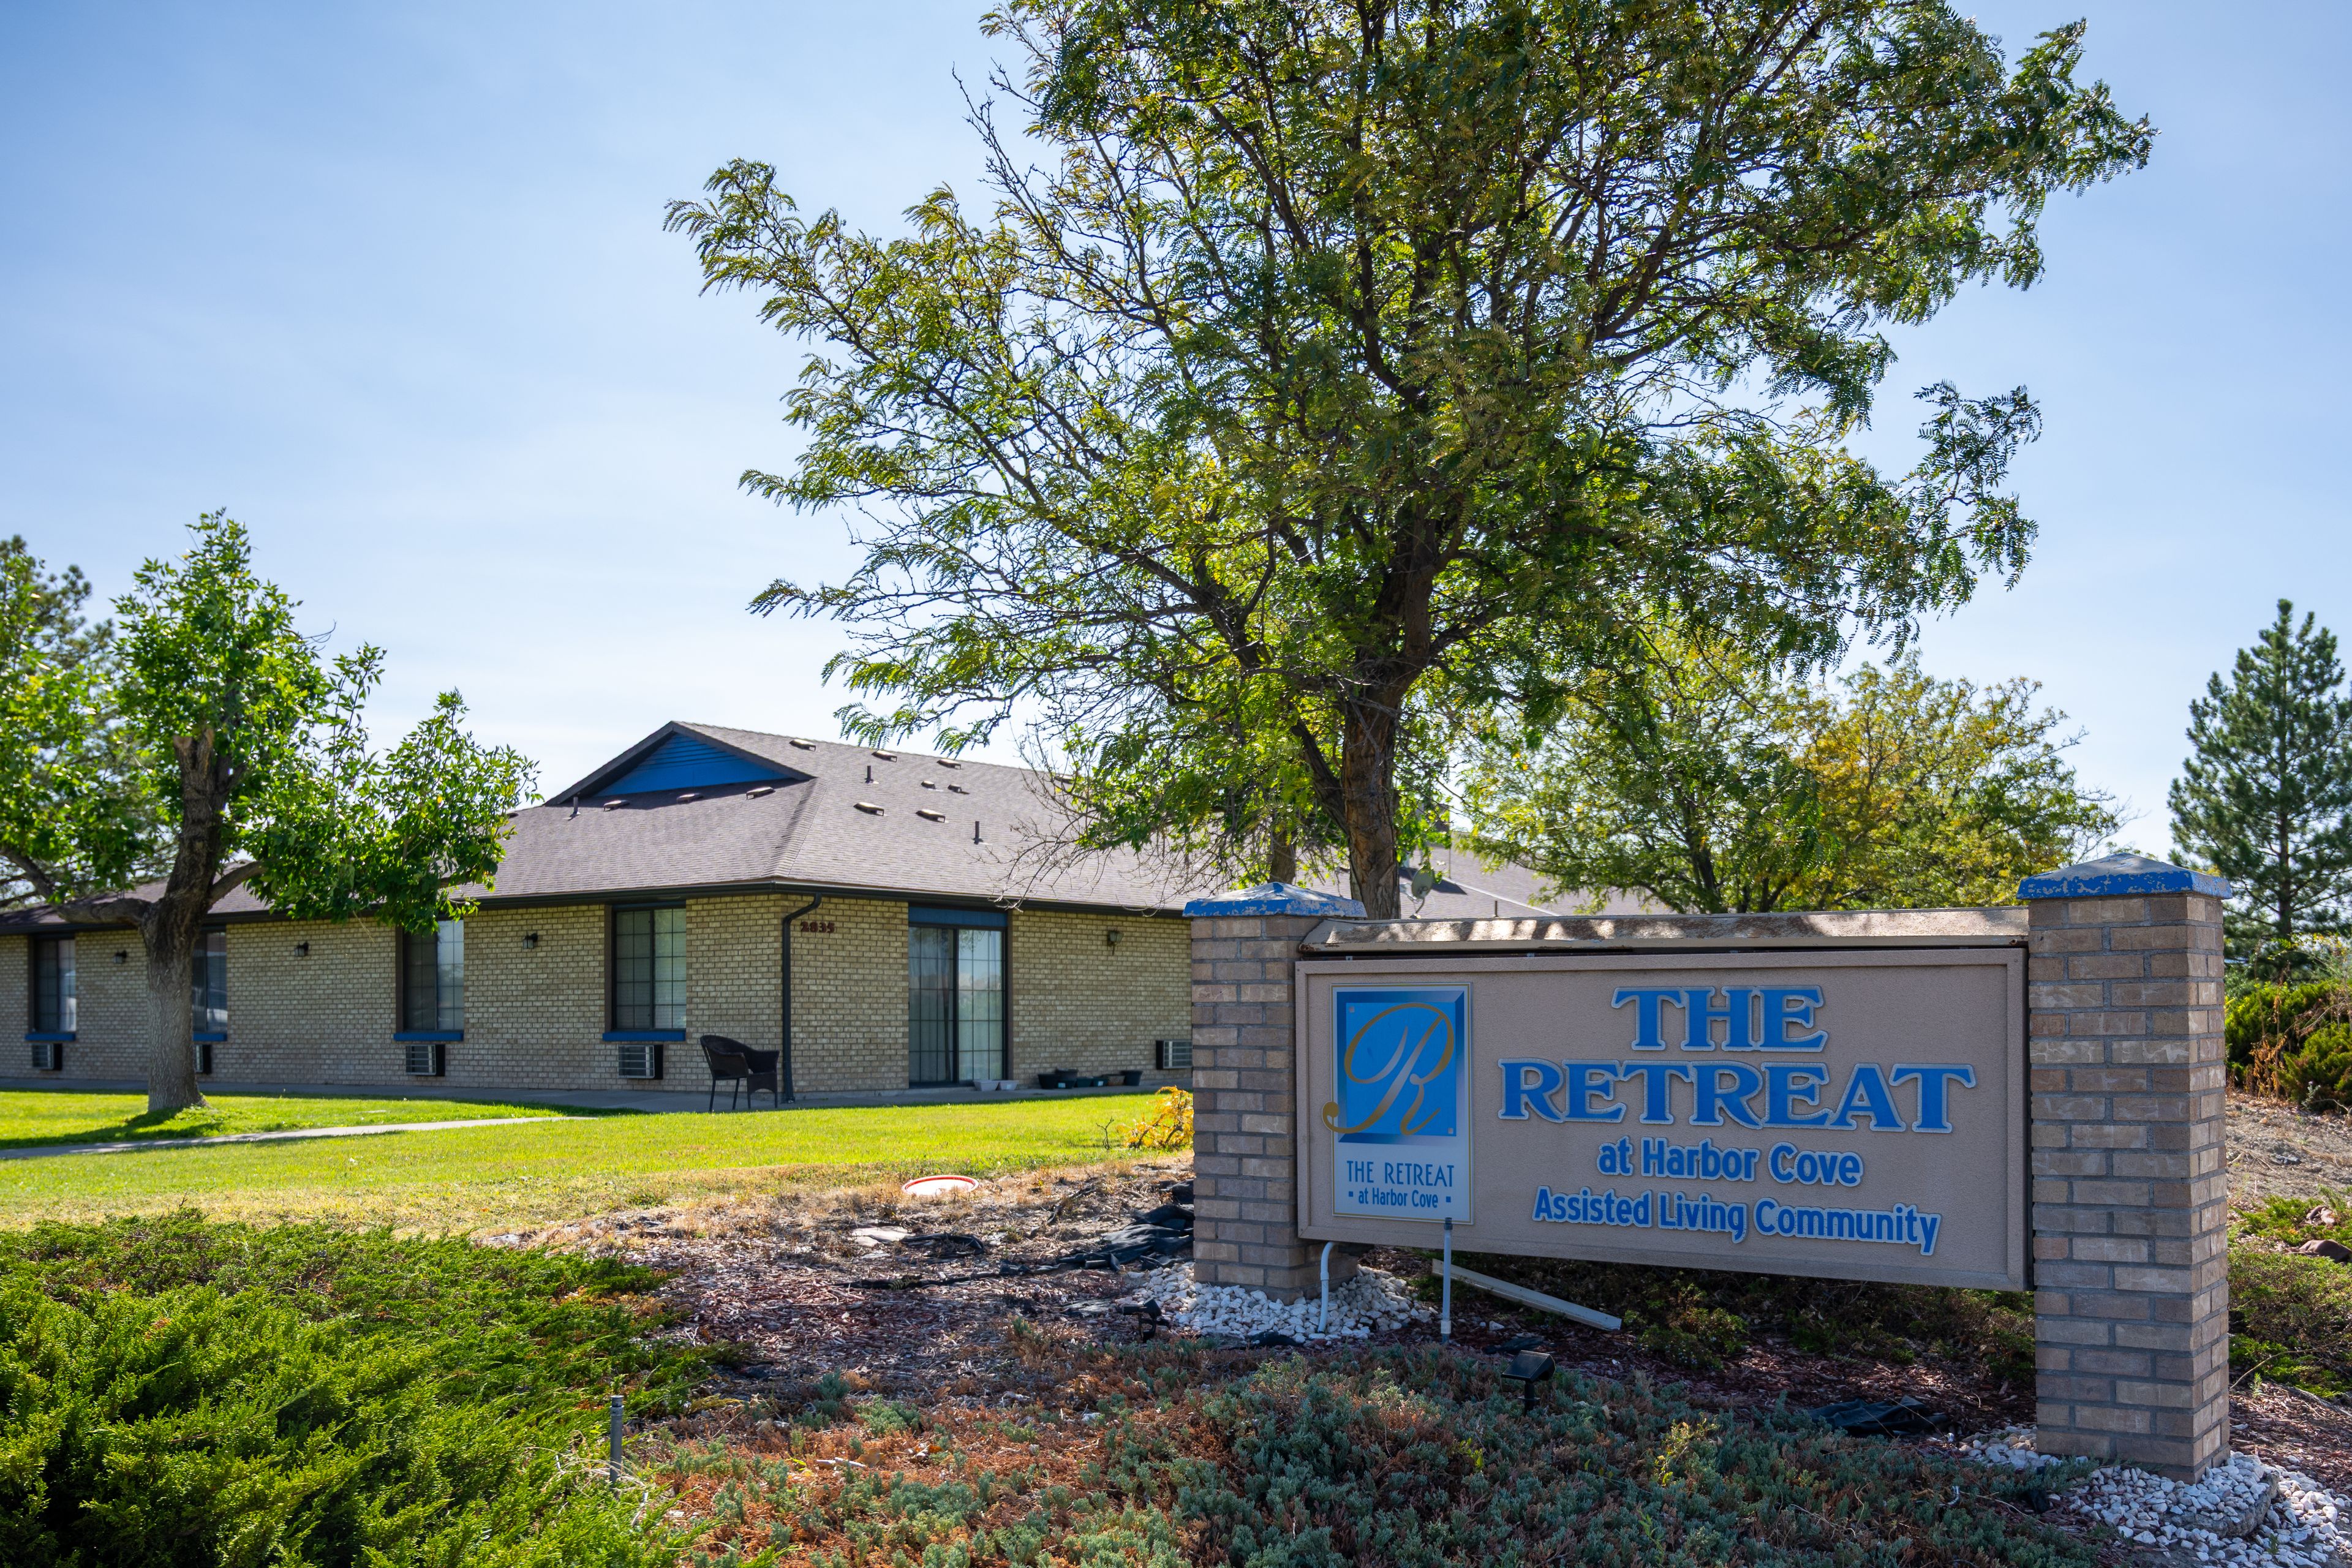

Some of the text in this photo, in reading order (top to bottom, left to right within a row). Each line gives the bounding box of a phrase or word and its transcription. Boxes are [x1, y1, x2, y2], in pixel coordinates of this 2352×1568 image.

[800, 921, 835, 933] 2835
[1612, 986, 1828, 1052] THE
[1322, 1003, 1455, 1136] R
[1498, 1058, 1976, 1133] RETREAT
[1347, 1161, 1455, 1187] THE RETREAT
[1597, 1136, 1863, 1187] at Harbor Cove
[1359, 1188, 1439, 1208] at Harbor Cove
[1532, 1186, 1942, 1255] Assisted Living Community
